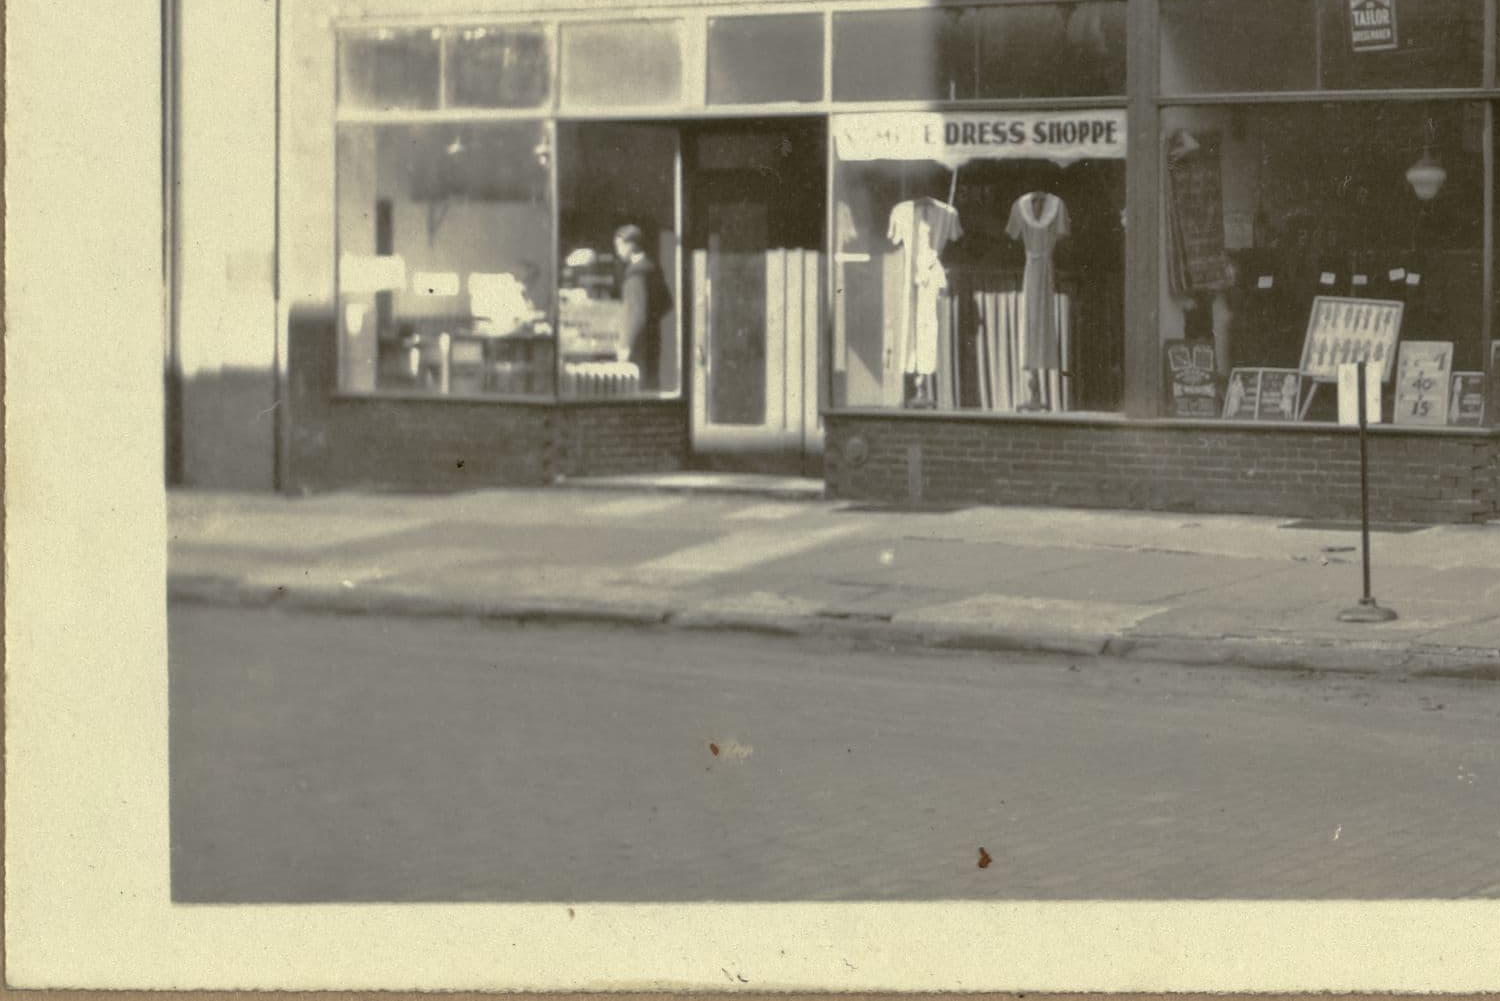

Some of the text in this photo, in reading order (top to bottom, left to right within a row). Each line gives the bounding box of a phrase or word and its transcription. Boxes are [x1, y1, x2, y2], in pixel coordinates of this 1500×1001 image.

[1351, 7, 1390, 27] TAILOR
[945, 120, 1024, 146] DRESS
[1032, 119, 1118, 145] SHOPPE
